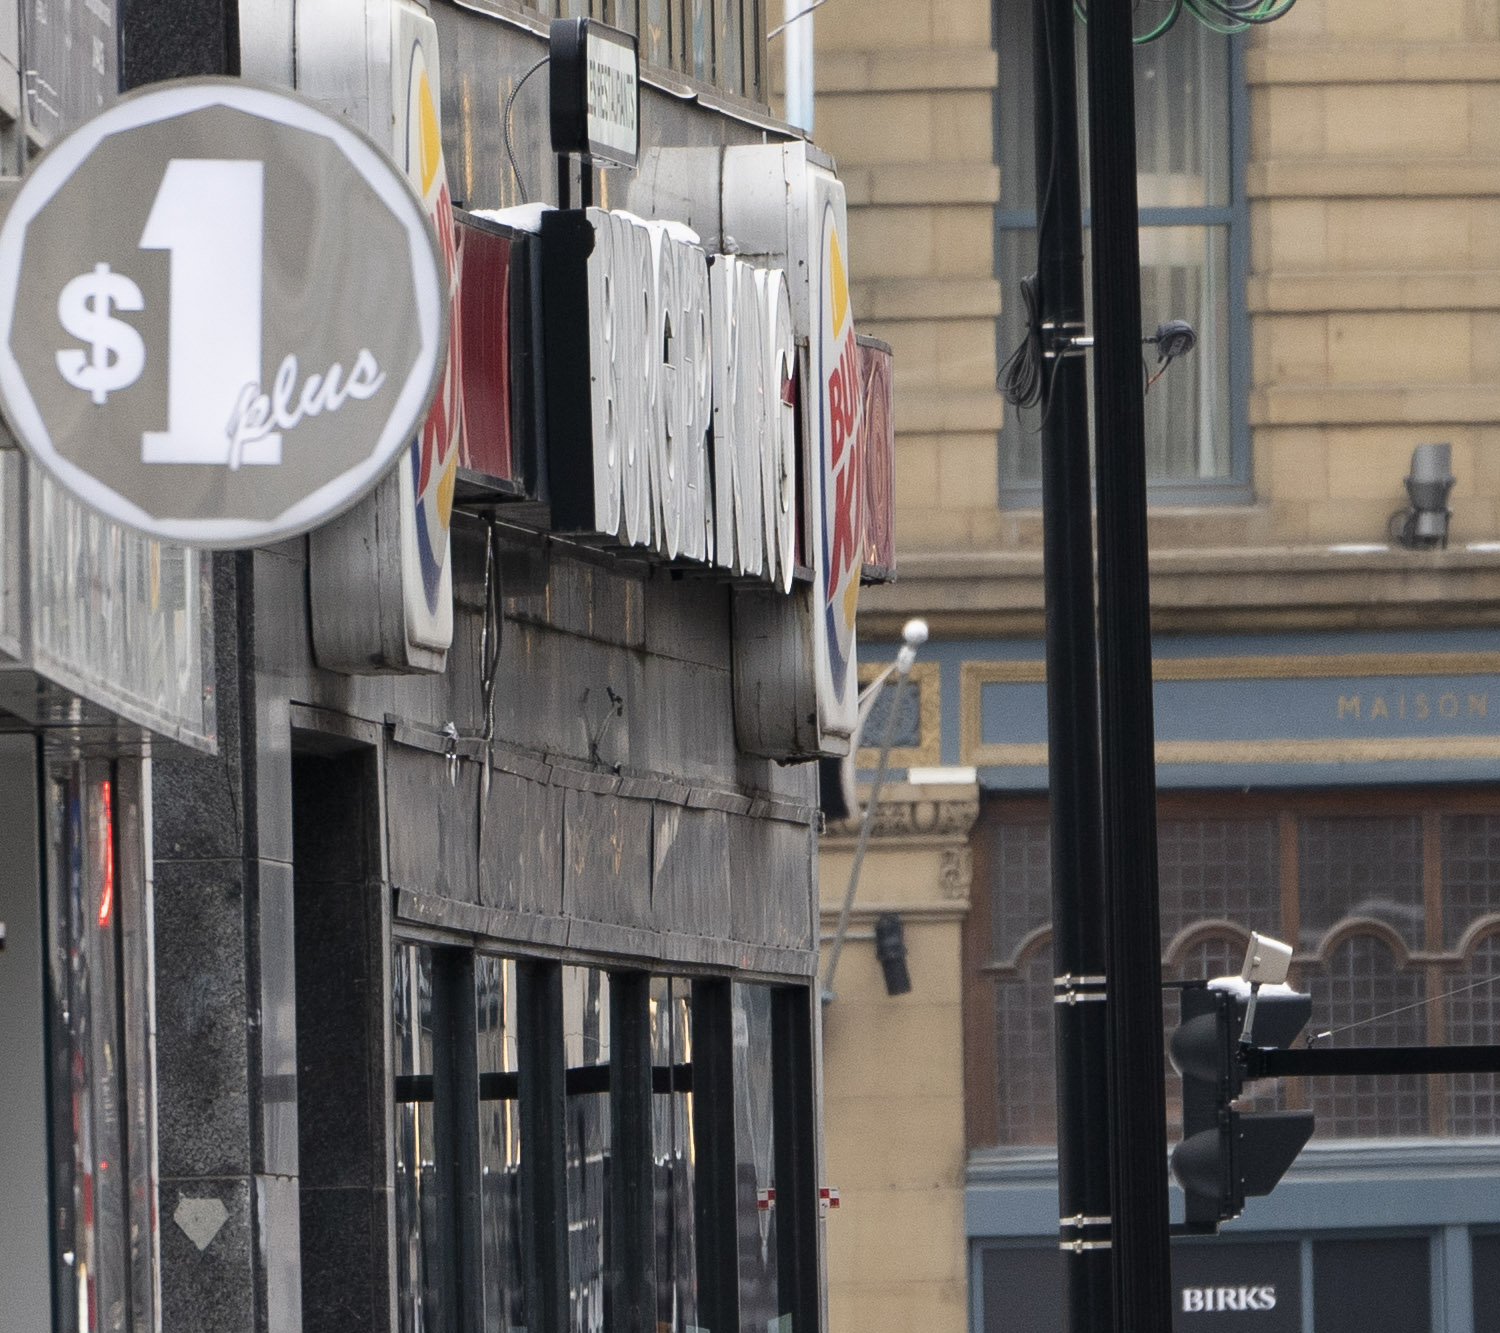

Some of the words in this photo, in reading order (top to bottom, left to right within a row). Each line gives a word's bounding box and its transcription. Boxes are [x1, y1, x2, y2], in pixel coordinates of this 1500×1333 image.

[226, 348, 386, 470] plus
[587, 206, 714, 568] BURGER
[709, 253, 795, 595] KING
[1336, 692, 1488, 720] MAISON
[1182, 1286, 1277, 1312] BIRKS
